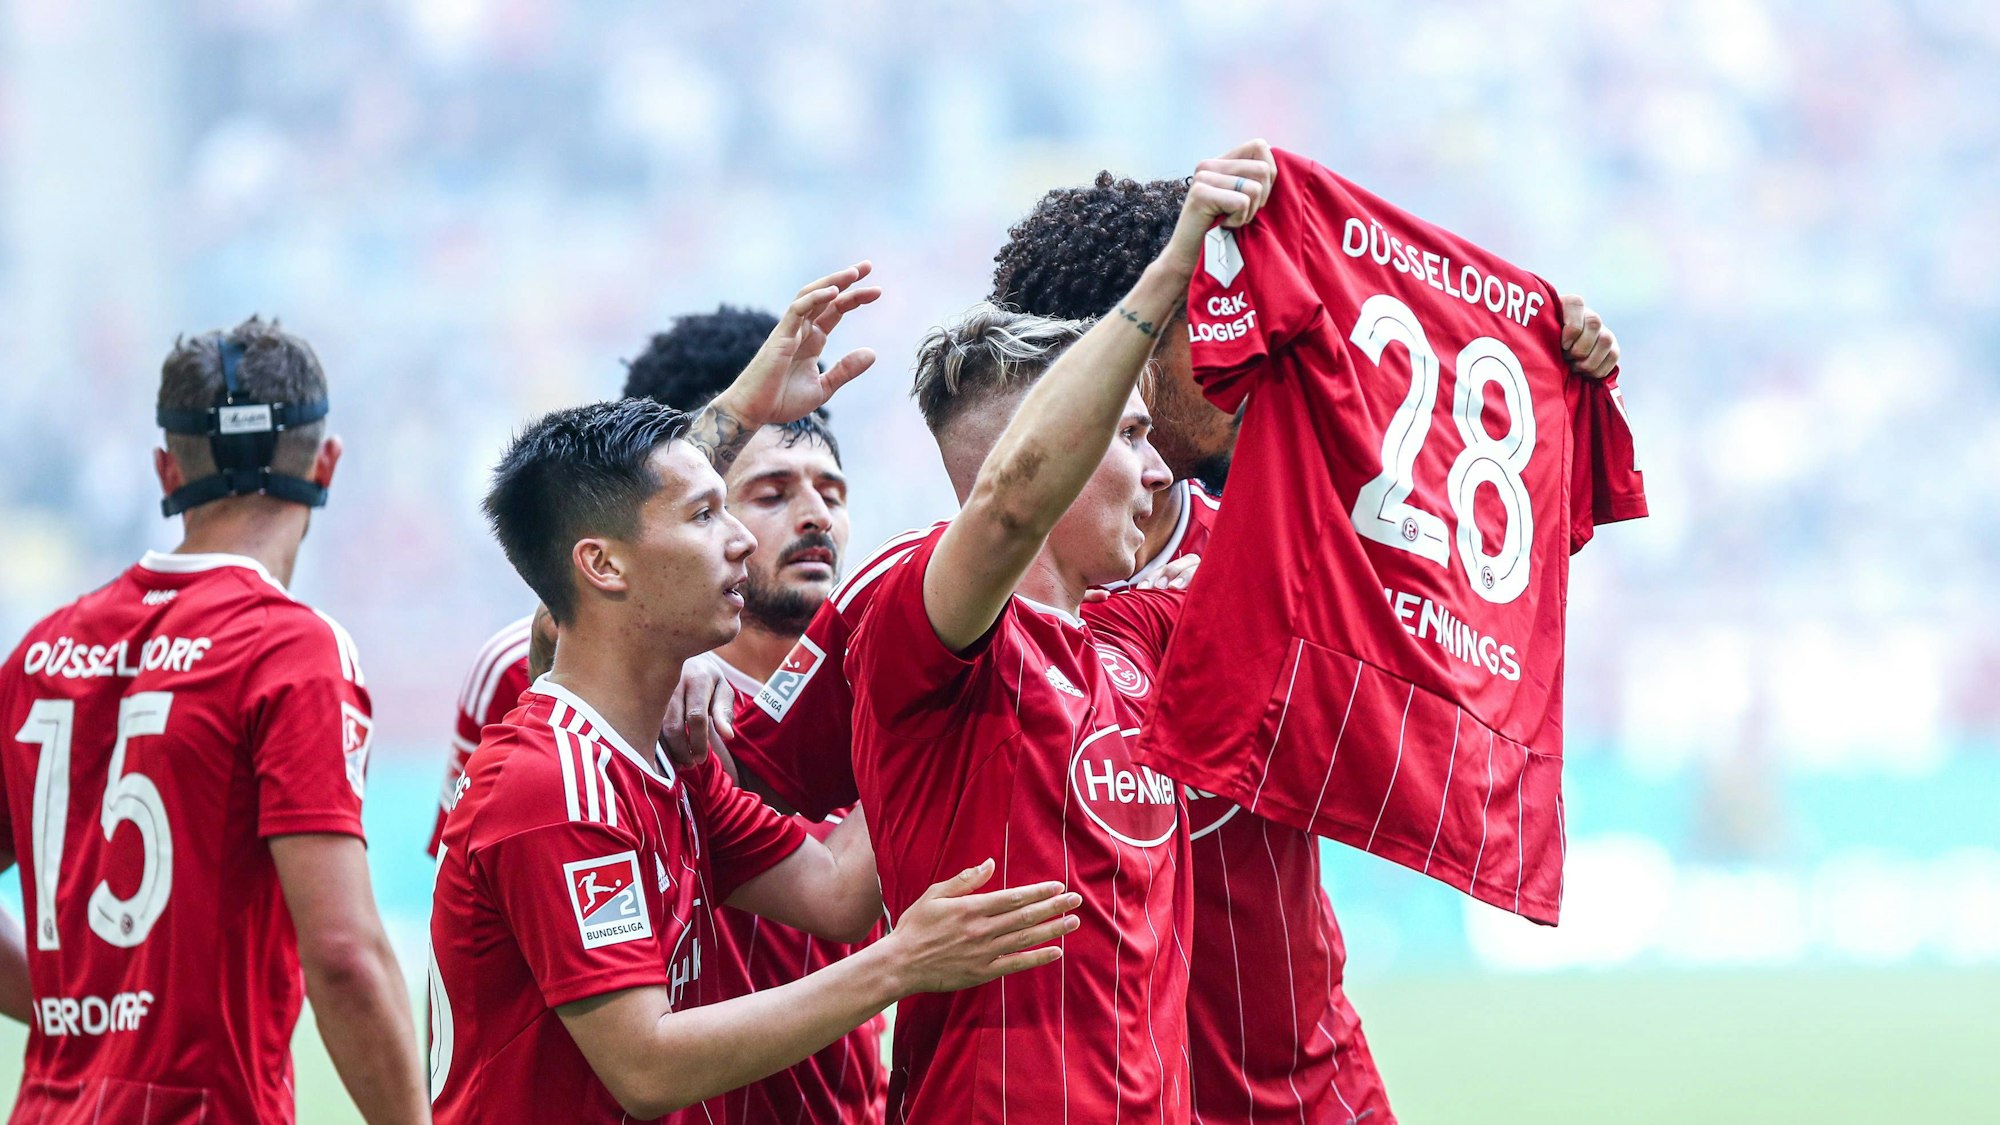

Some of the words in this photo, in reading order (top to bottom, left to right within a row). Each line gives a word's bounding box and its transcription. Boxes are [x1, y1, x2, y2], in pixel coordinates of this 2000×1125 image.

[1207, 291, 1248, 316] C&K
[1342, 217, 1545, 328] DÜSSELDORF
[1187, 309, 1256, 343] LOGIST
[1349, 293, 1537, 605] 28
[1384, 587, 1521, 681] ENNINGS
[14, 691, 175, 951] 15
[586, 921, 644, 941] BUNDESLIGA
[618, 888, 637, 916] 2
